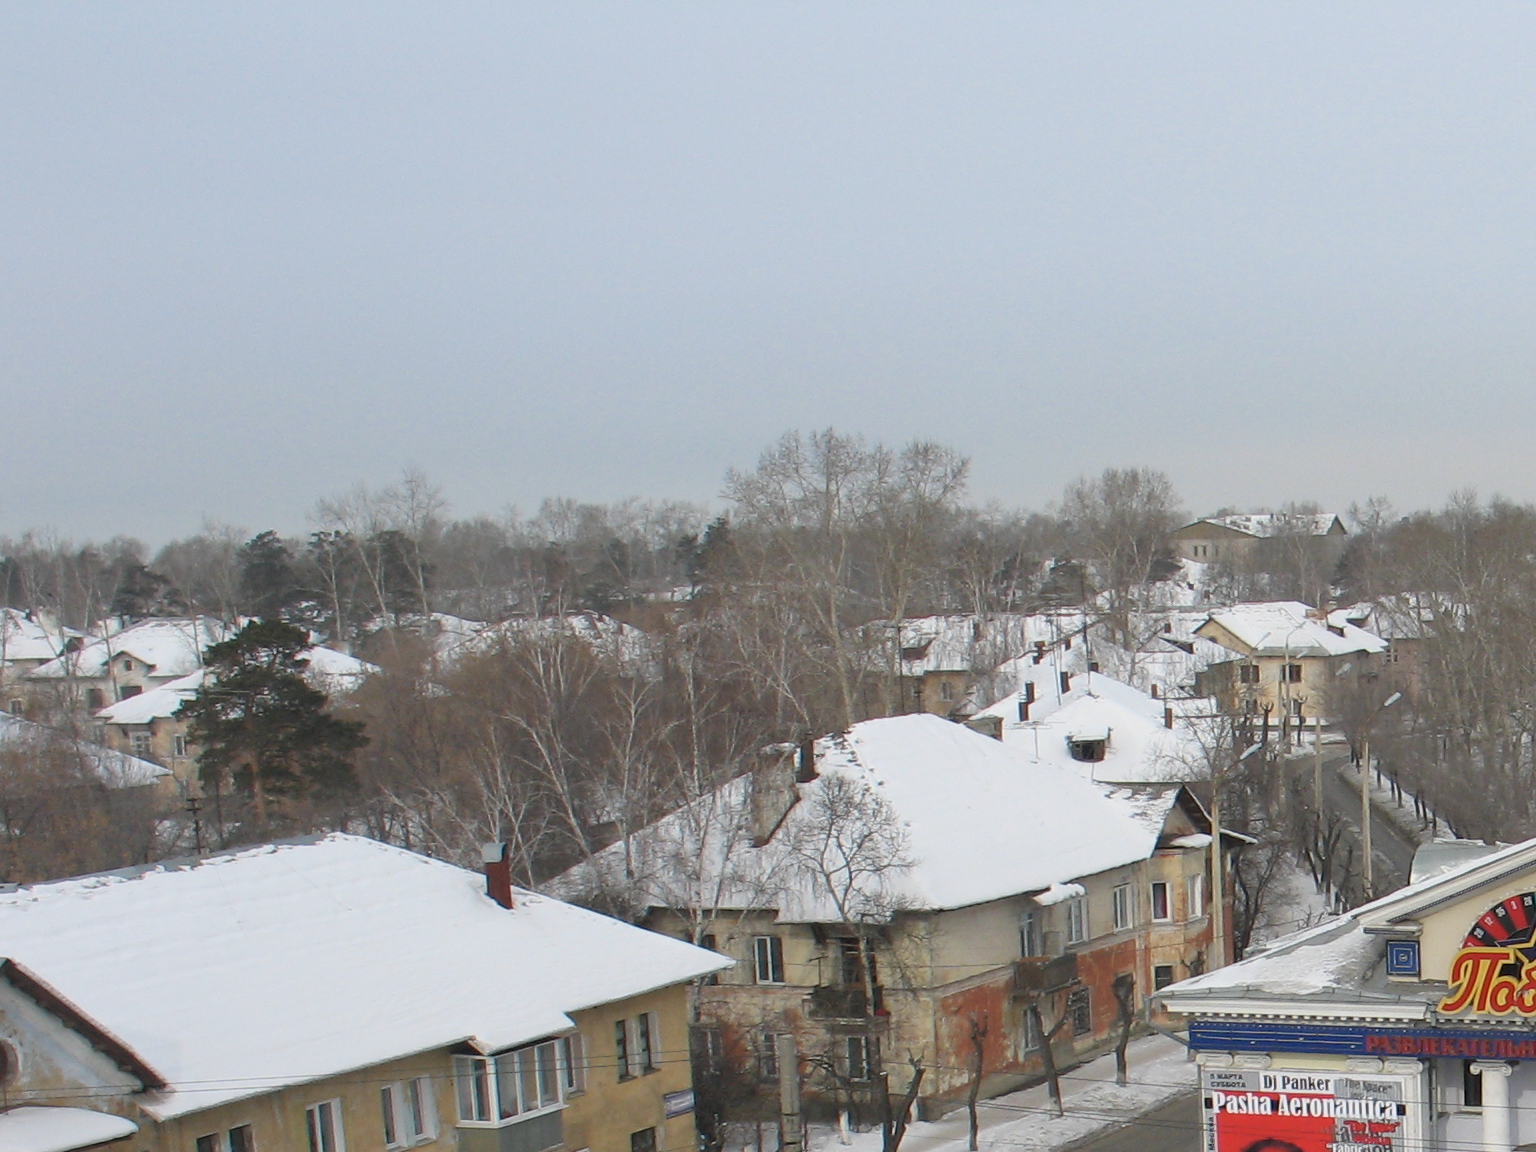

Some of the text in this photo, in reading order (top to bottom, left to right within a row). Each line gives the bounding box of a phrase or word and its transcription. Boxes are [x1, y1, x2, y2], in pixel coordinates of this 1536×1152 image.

[1210, 1081, 1247, 1089] СУББОТА
[1263, 1074, 1331, 1091] Dj Panker
[1212, 1091, 1398, 1119] Pasha Aeronautica
